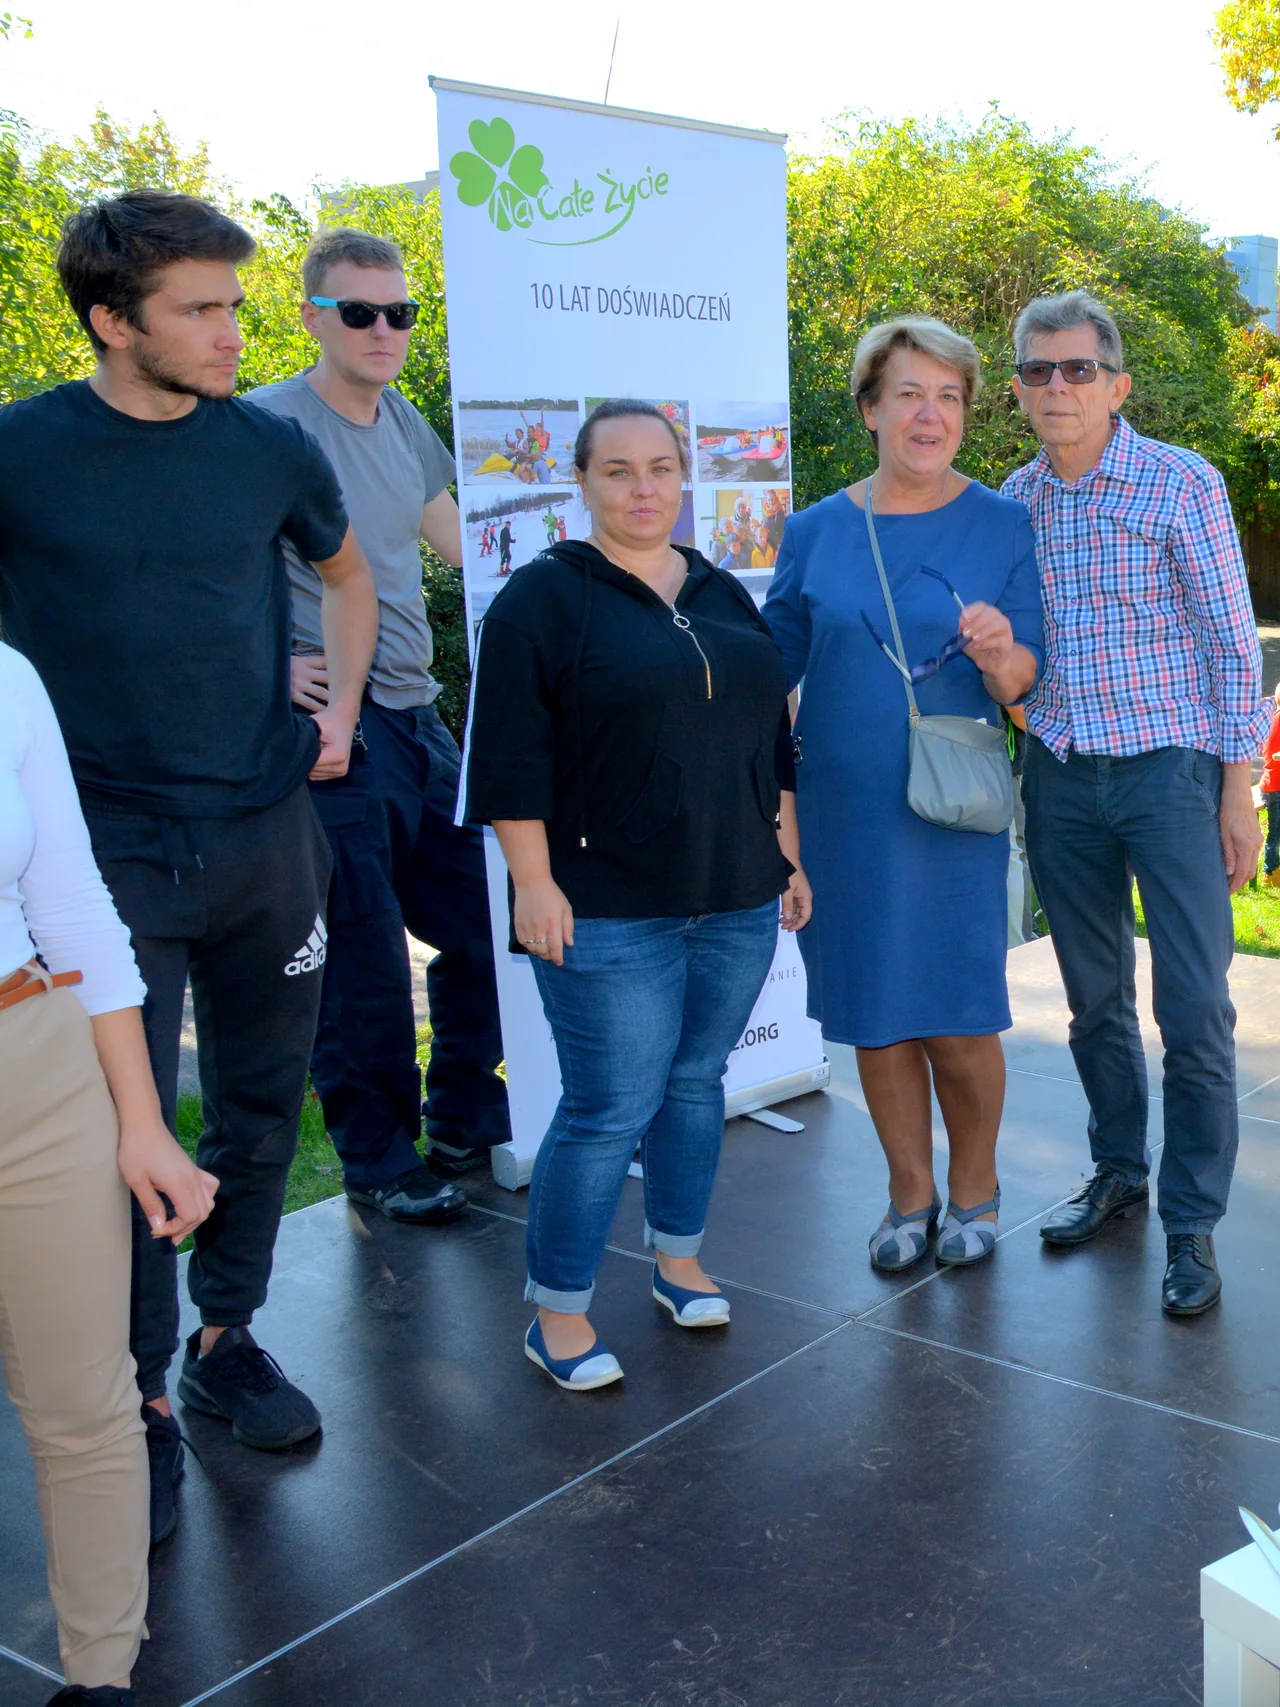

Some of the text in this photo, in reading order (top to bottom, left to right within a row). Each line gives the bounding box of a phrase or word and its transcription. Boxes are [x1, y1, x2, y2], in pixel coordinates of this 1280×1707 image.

[491, 187, 534, 229] Na
[596, 166, 669, 246] Życie
[530, 282, 731, 322] 10 LAT DOŚWIADCZEŃ
[284, 944, 326, 976] adid
[770, 967, 797, 983] ANIE
[733, 1023, 779, 1051] .ORG
